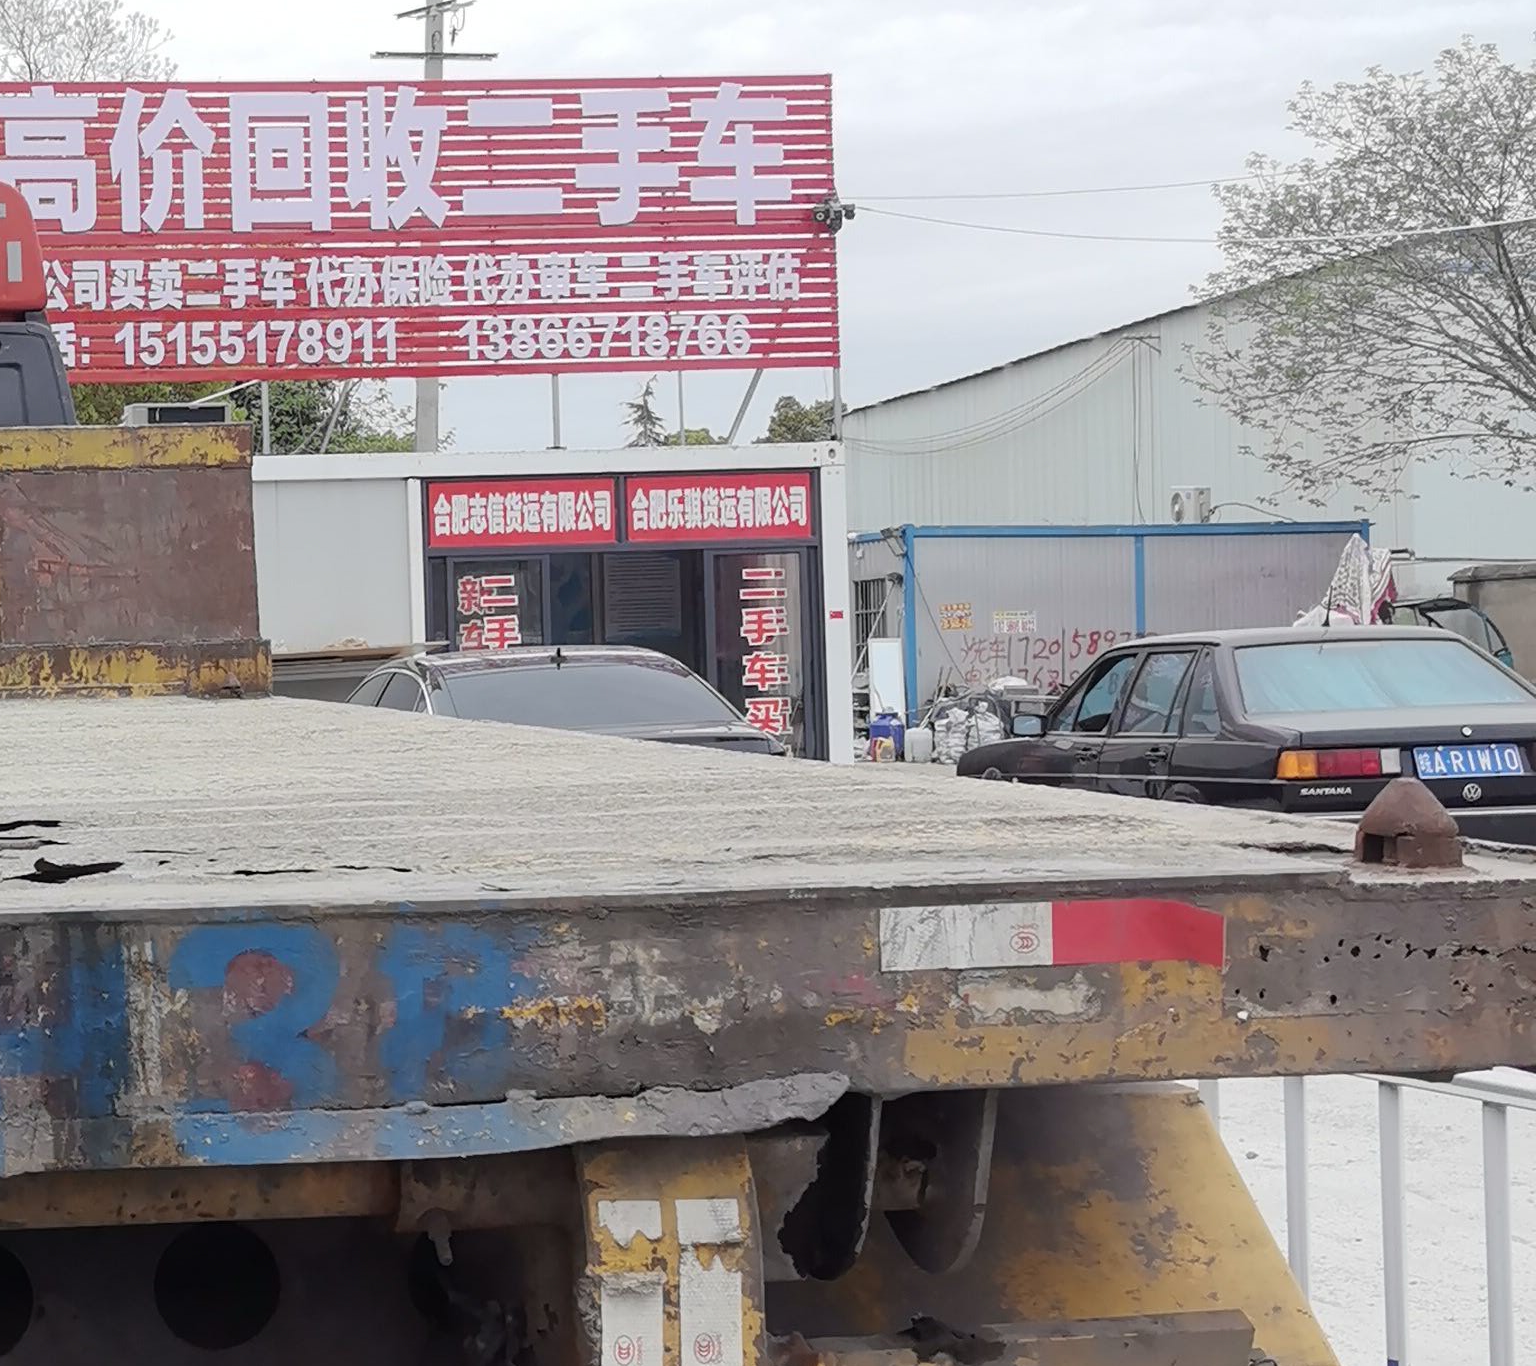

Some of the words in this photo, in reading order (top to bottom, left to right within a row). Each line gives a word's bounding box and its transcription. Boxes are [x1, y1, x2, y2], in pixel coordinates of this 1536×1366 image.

[42, 258, 298, 312] 公司买卖二手车
[305, 255, 454, 309] 代办保险
[618, 250, 802, 302] 二手车评估
[115, 319, 399, 367] 15155178911
[457, 313, 752, 361] 13866718766
[433, 490, 612, 536] 合肥志信货运有限公司
[1299, 786, 1353, 796] SANTANA
